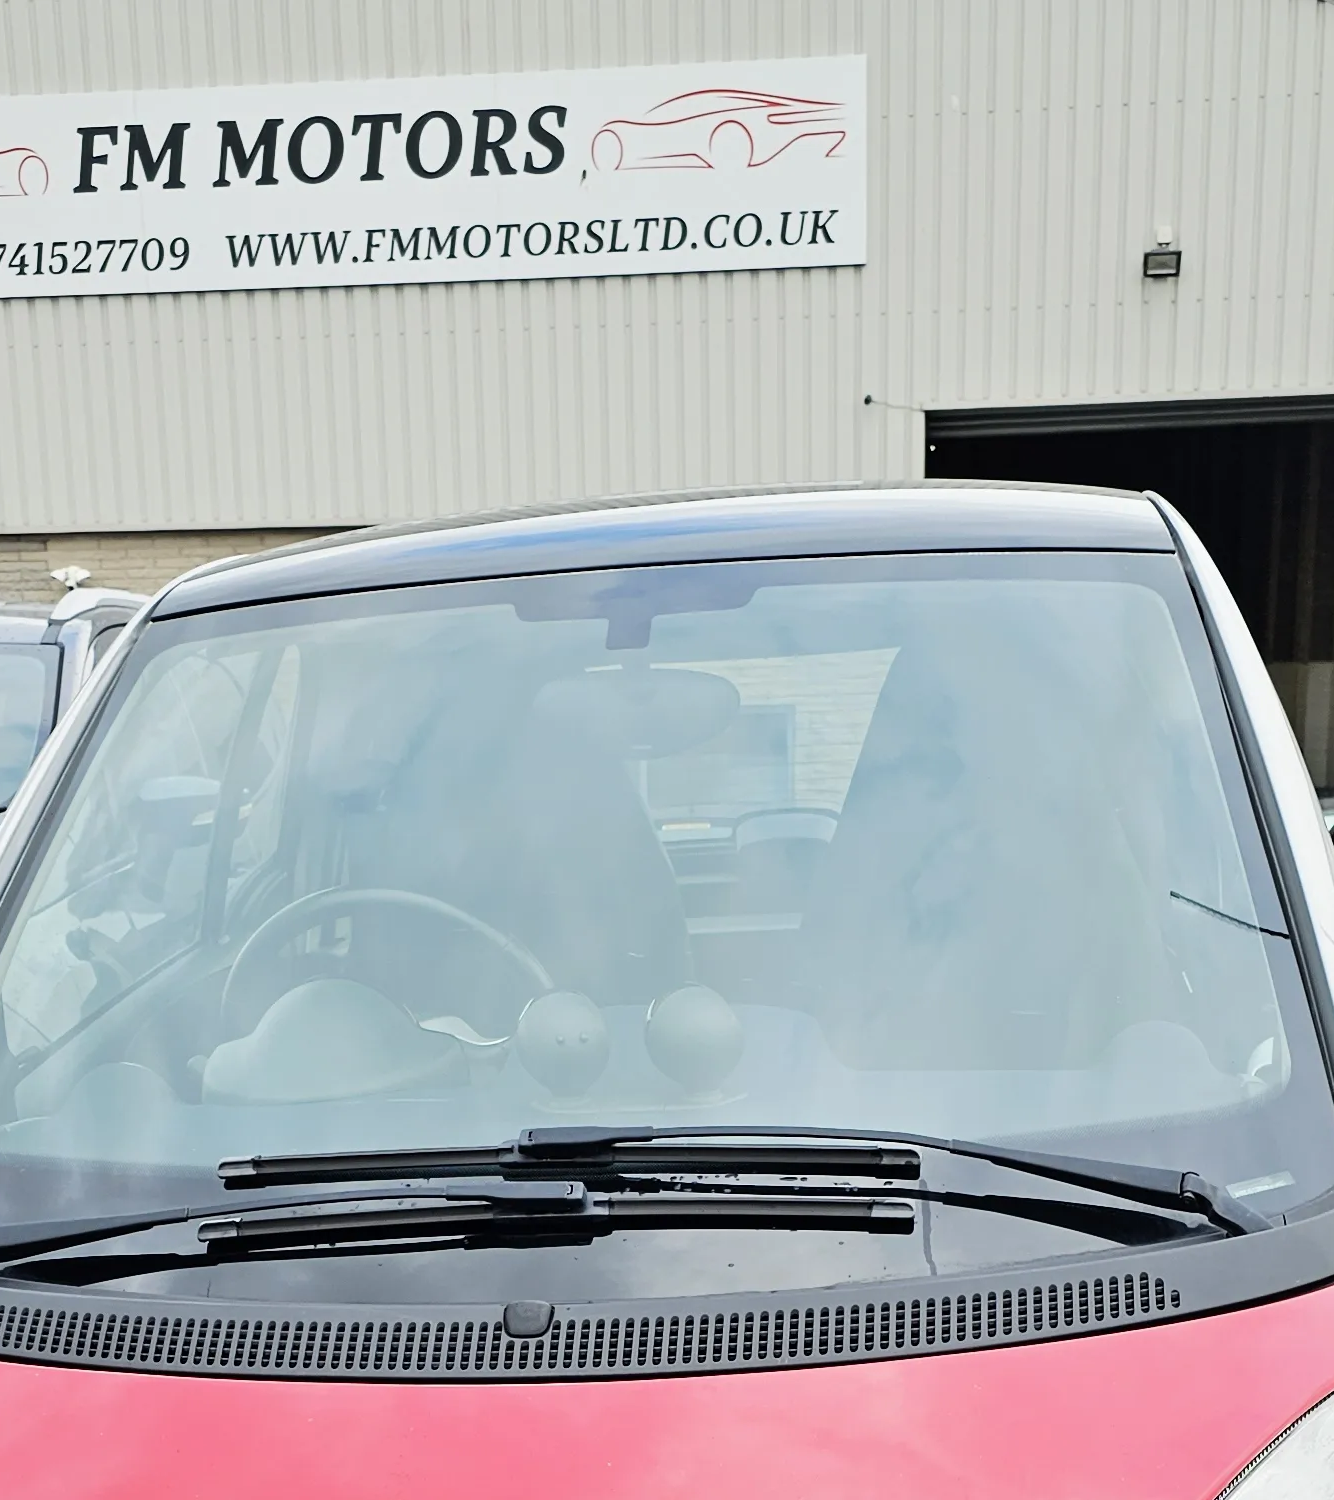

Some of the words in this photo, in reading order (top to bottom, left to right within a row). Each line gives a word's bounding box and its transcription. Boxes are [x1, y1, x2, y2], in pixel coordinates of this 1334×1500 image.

[72, 122, 191, 194] FM
[212, 105, 568, 188] MOTORS
[225, 209, 839, 268] WWW.FMMOTORSLTD.CO.UK
